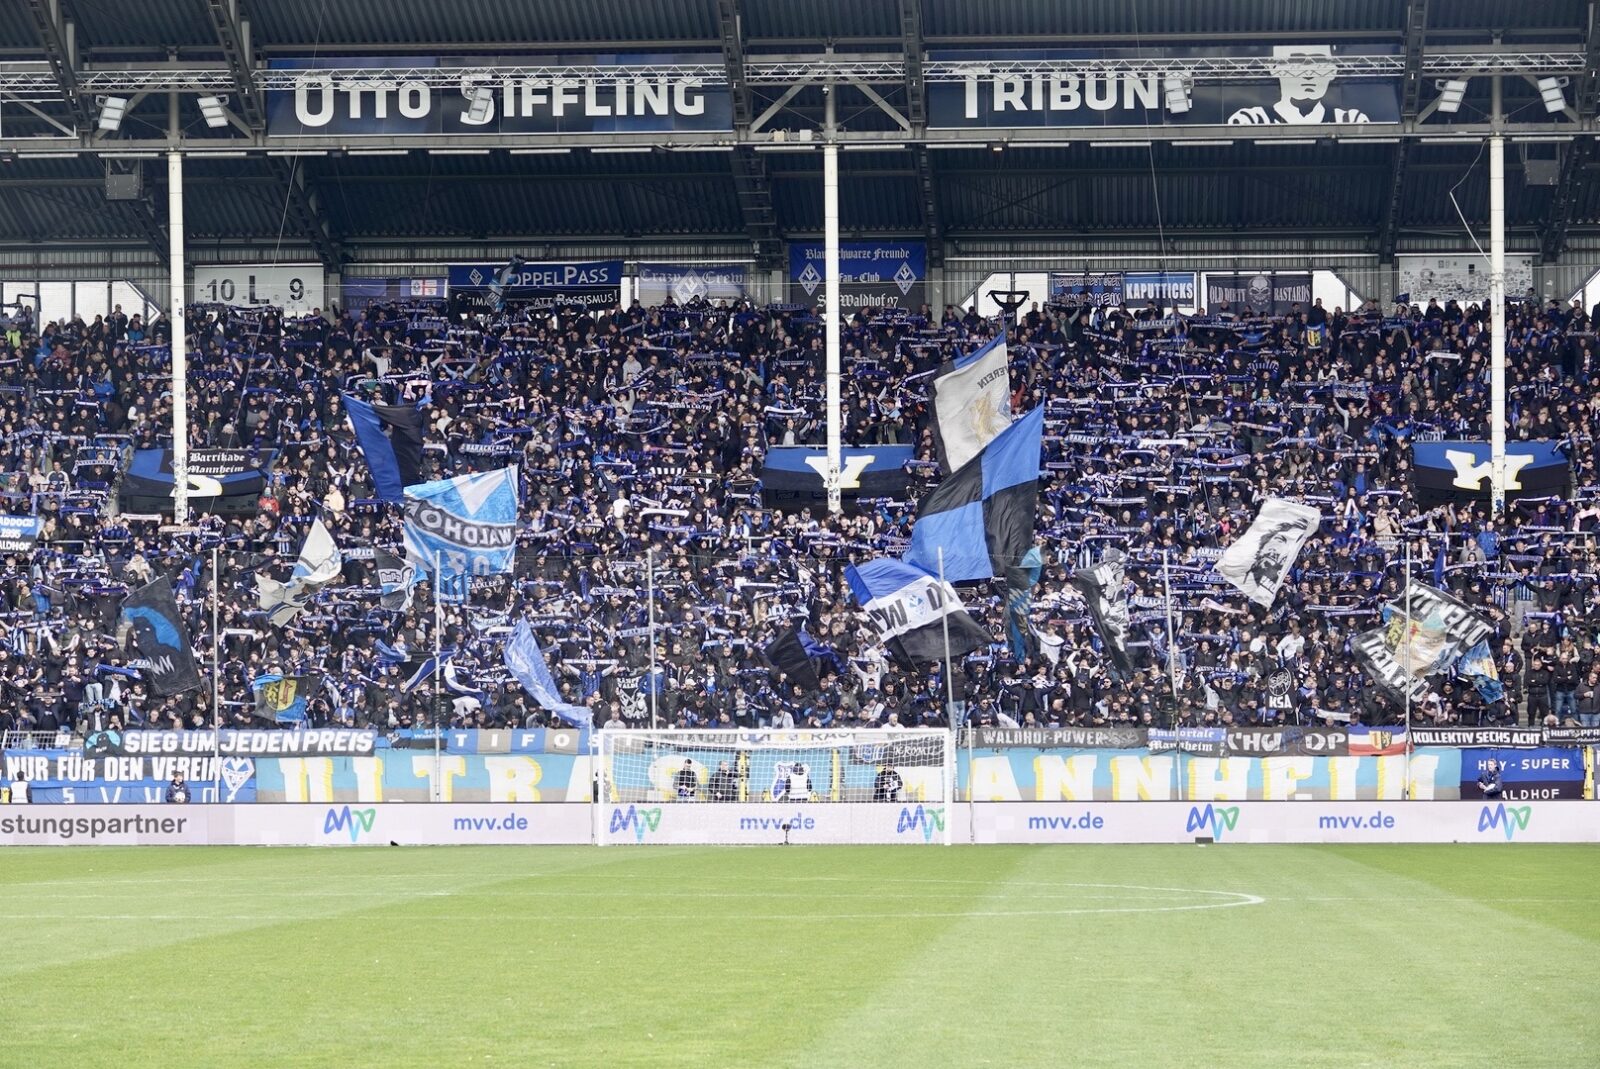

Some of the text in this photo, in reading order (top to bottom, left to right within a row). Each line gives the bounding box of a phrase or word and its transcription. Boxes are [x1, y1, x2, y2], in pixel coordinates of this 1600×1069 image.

[1126, 282, 1193, 300] KAPUTTICKS
[1274, 288, 1311, 303] BASTARDS
[189, 452, 245, 463] Barrikade
[125, 730, 375, 753] SIEG UM JEDEN PREIS
[1412, 731, 1541, 745] KOLLEKTIV SECHS ACHT
[6, 755, 223, 782] NUR FÜR DEN VEREIN
[1521, 758, 1570, 770] SUPER
[0, 813, 188, 838] stungspartner
[453, 812, 529, 831] mvv.de
[739, 812, 816, 831] mvv.de
[1027, 811, 1105, 830] mvv.de
[1319, 810, 1395, 829] mvv.de
